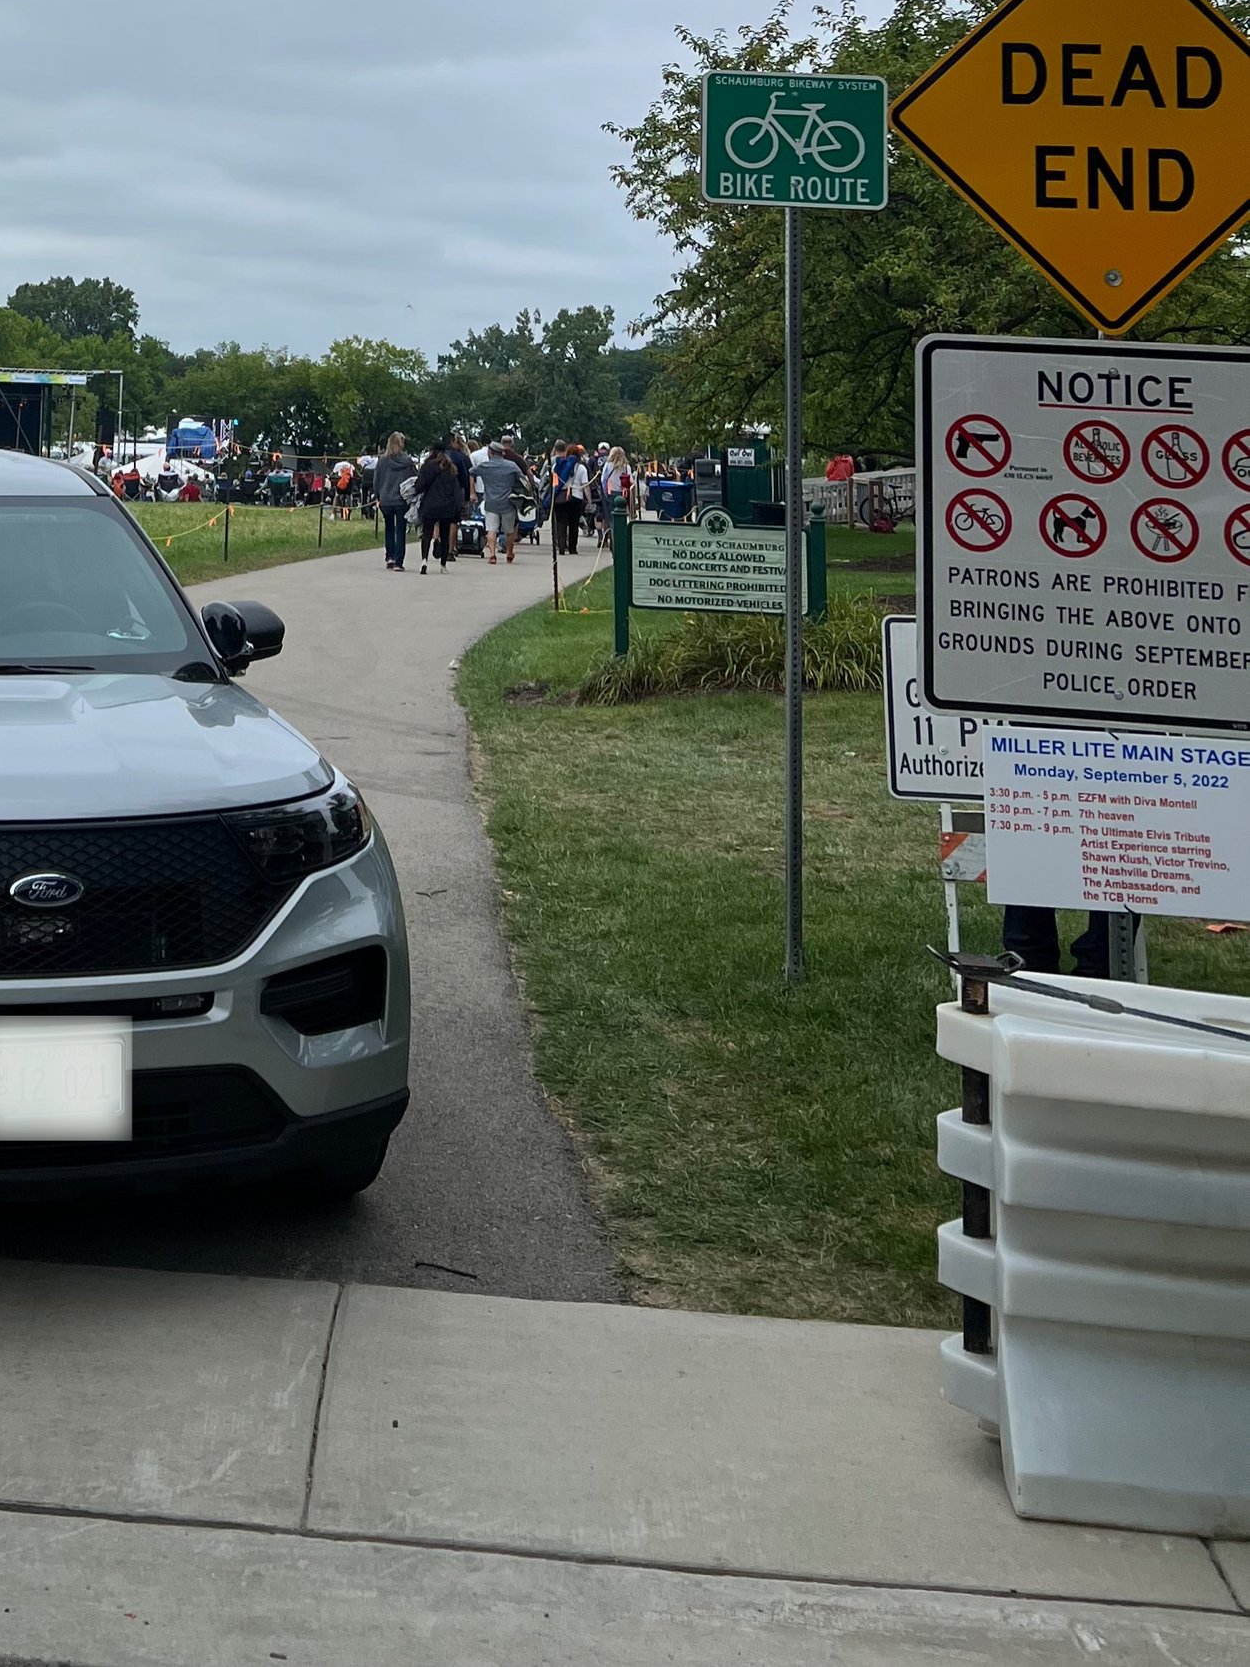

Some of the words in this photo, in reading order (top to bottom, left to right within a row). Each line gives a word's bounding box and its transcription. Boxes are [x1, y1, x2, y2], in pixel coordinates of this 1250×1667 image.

[716, 76, 784, 87] SCHAUMBURG
[790, 79, 832, 89] BIKEWAY
[838, 81, 877, 91] SYSTEM
[1002, 43, 1222, 109] DEAD
[720, 173, 774, 198] BIKE
[790, 176, 870, 202] ROUTE
[1035, 145, 1195, 212] END
[1038, 370, 1193, 408] NOTICE
[1156, 450, 1197, 461] GLSS
[655, 537, 696, 547] VILLAGE
[715, 541, 785, 552] SCHAUMBURG
[673, 551, 686, 559] NO
[690, 552, 716, 560] DOGS
[719, 553, 765, 562] ALLOWED
[639, 560, 676, 570] DURING
[679, 562, 727, 573] CONCERTS
[730, 565, 750, 574] AND
[650, 578, 671, 587] DOG
[673, 579, 724, 590] LITTERING
[949, 567, 1039, 588] PATRONS
[1051, 573, 1091, 592] ARE
[1104, 576, 1223, 600] PROHIBITED
[658, 595, 672, 604] NO
[675, 596, 733, 607] MOTORIZED
[736, 599, 782, 610] VEHICLES
[950, 600, 1044, 622] BRINGING
[1057, 606, 1094, 625] THE
[1106, 610, 1174, 631] ABOVE
[1187, 615, 1240, 635] ONTO
[939, 632, 1034, 655] GROUNDS
[1047, 639, 1123, 660] DURING
[1043, 673, 1114, 694] POLICE
[1128, 678, 1196, 700] ORDER
[913, 716, 933, 745] 11
[992, 737, 1065, 756] MILLER
[1072, 741, 1115, 758] LITE
[1122, 744, 1173, 762] MAIN
[1181, 748, 1250, 766] STAGE
[1014, 763, 1078, 782] Monday,
[1084, 768, 1168, 784] September
[1173, 773, 1187, 788] 5,
[1192, 774, 1229, 788] 2022
[990, 788, 1010, 798] 3:30
[1013, 789, 1033, 801] p.m.
[1043, 791, 1049, 800] 5
[1052, 792, 1071, 803] p.m.
[1078, 793, 1107, 804] EZFM
[1109, 794, 1130, 805] with
[1134, 796, 1156, 806] Diva
[1160, 798, 1197, 809] Montell
[990, 804, 1011, 814] 5:30
[1014, 805, 1034, 817] p.m.
[1043, 808, 1049, 816] 7
[1052, 808, 1073, 819] p.m.
[1079, 809, 1095, 819] 7th
[1098, 810, 1134, 821] heaven
[991, 820, 1011, 830] 7:30
[1014, 821, 1035, 833] p.m.
[1044, 824, 1050, 833] 9
[1053, 825, 1073, 835] p.m.
[1080, 825, 1098, 835] The
[1102, 827, 1143, 839] Ultimate
[1147, 830, 1171, 840] Elvis
[1174, 831, 1210, 843] Tribute
[1081, 839, 1108, 849] Artist
[1112, 840, 1168, 854] Experience
[1171, 845, 1211, 858] starring
[1082, 852, 1116, 863] Shawn
[1119, 854, 1151, 866] Klush,
[1154, 857, 1185, 867] Victor
[1188, 859, 1230, 871] Trevino,
[1083, 865, 1098, 875] the
[1101, 867, 1148, 878] Nashville
[1151, 870, 1193, 881] Dreams,
[29, 881, 67, 899] Ford
[1083, 878, 1101, 888] The
[1104, 879, 1178, 894] Ambassadors,
[1181, 885, 1200, 895] and
[1083, 891, 1099, 901] the
[1102, 892, 1124, 902] TCB
[1127, 894, 1158, 905] Horns
